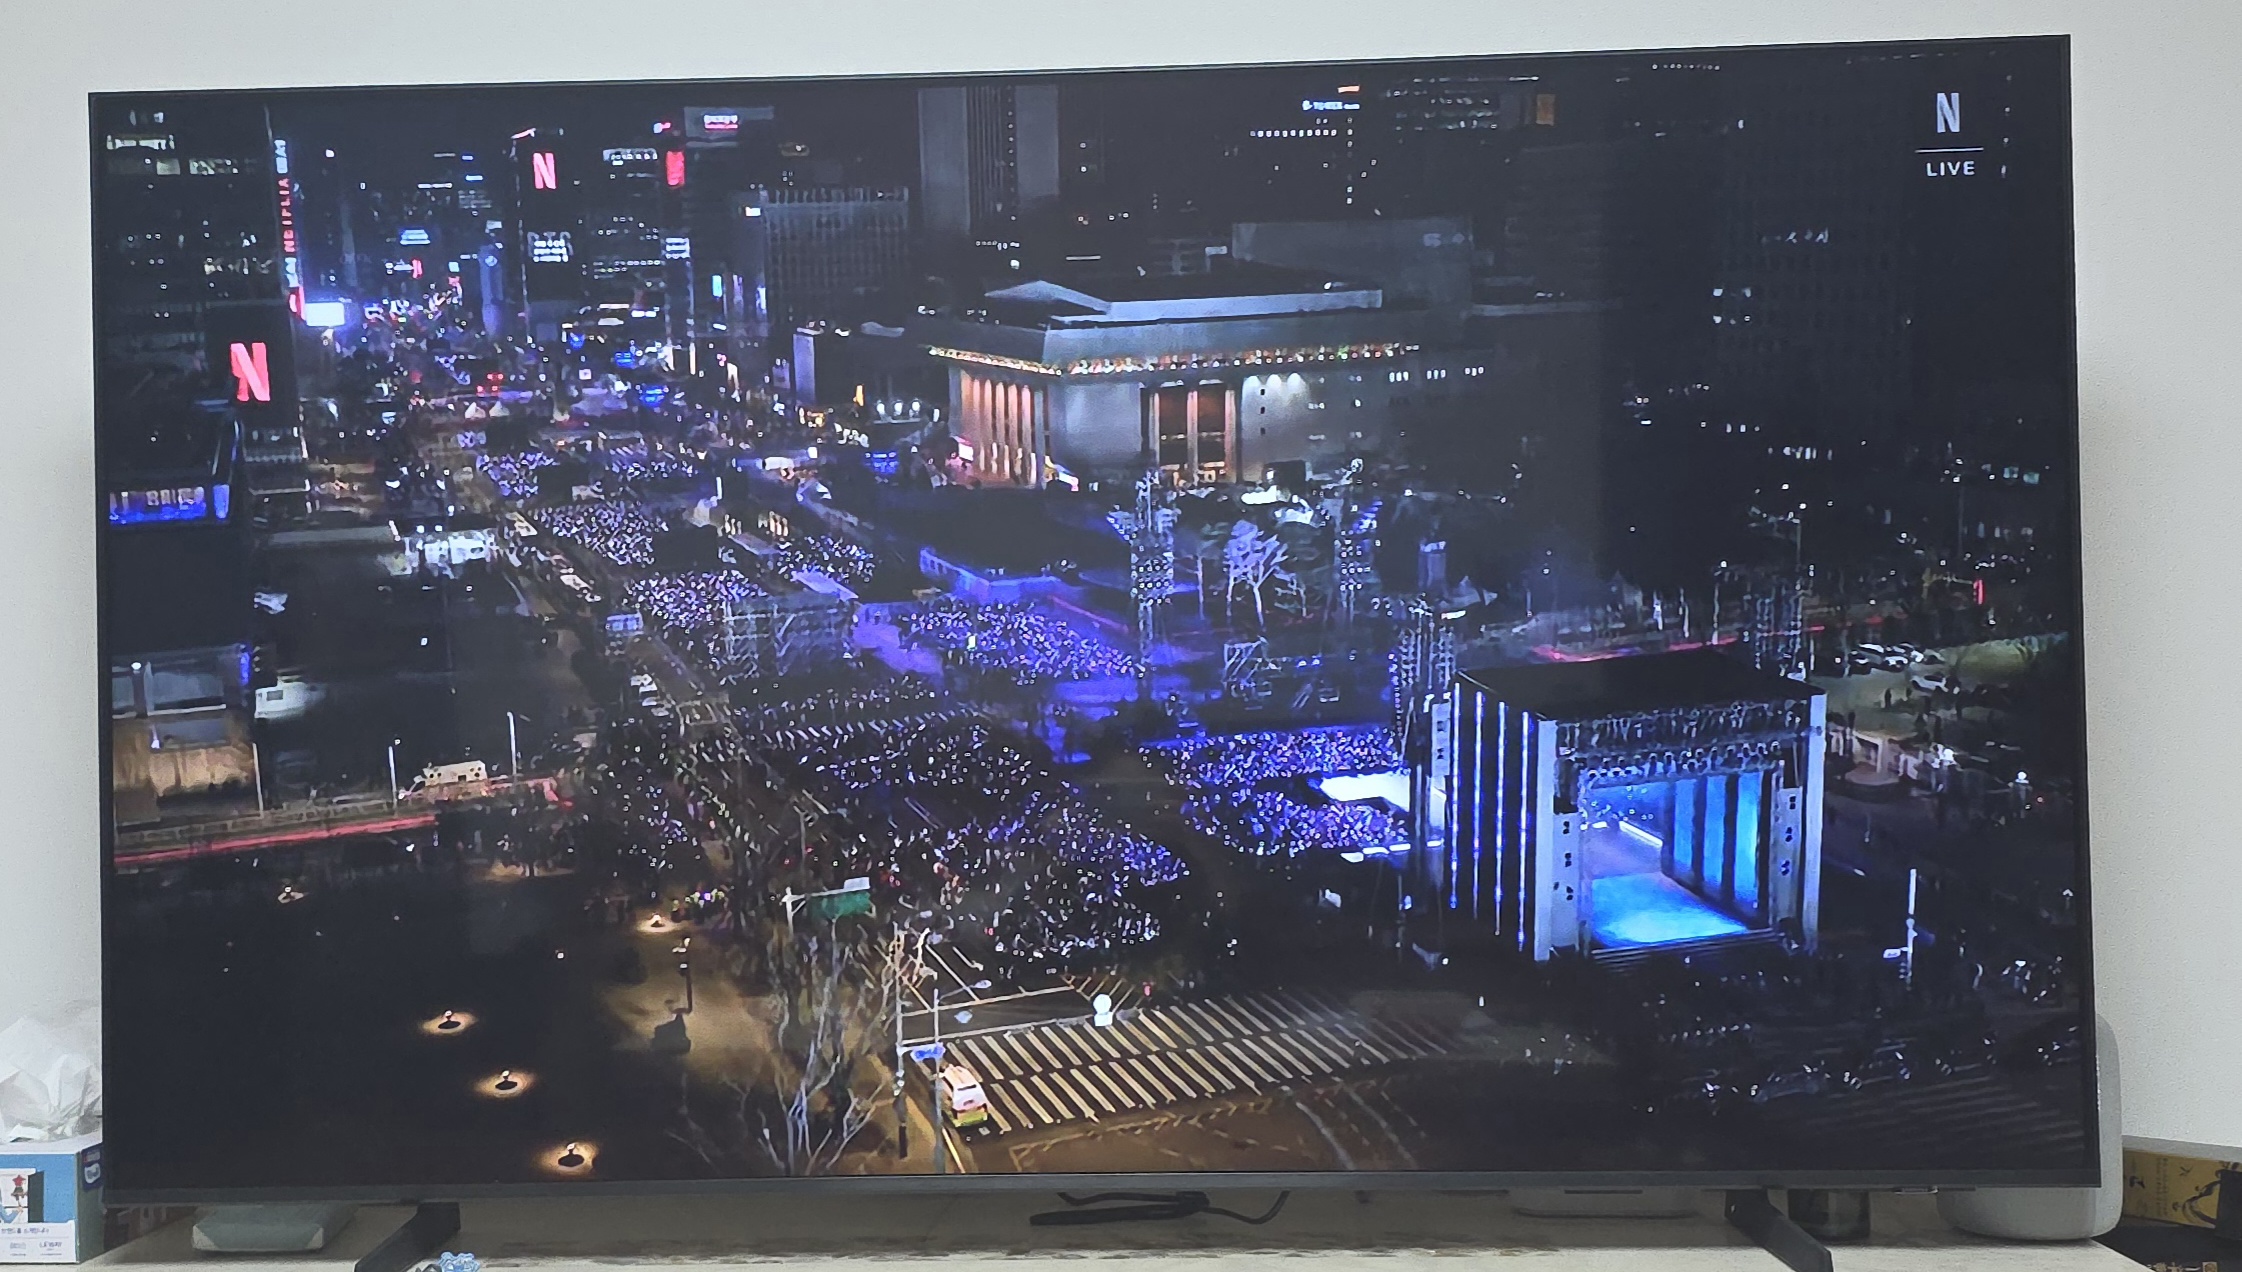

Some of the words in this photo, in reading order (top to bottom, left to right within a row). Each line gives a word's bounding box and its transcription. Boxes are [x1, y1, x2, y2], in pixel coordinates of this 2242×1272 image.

[1937, 92, 1960, 133] N
[533, 152, 557, 190] N
[1926, 160, 1976, 177] LIVE
[230, 341, 271, 402] N
